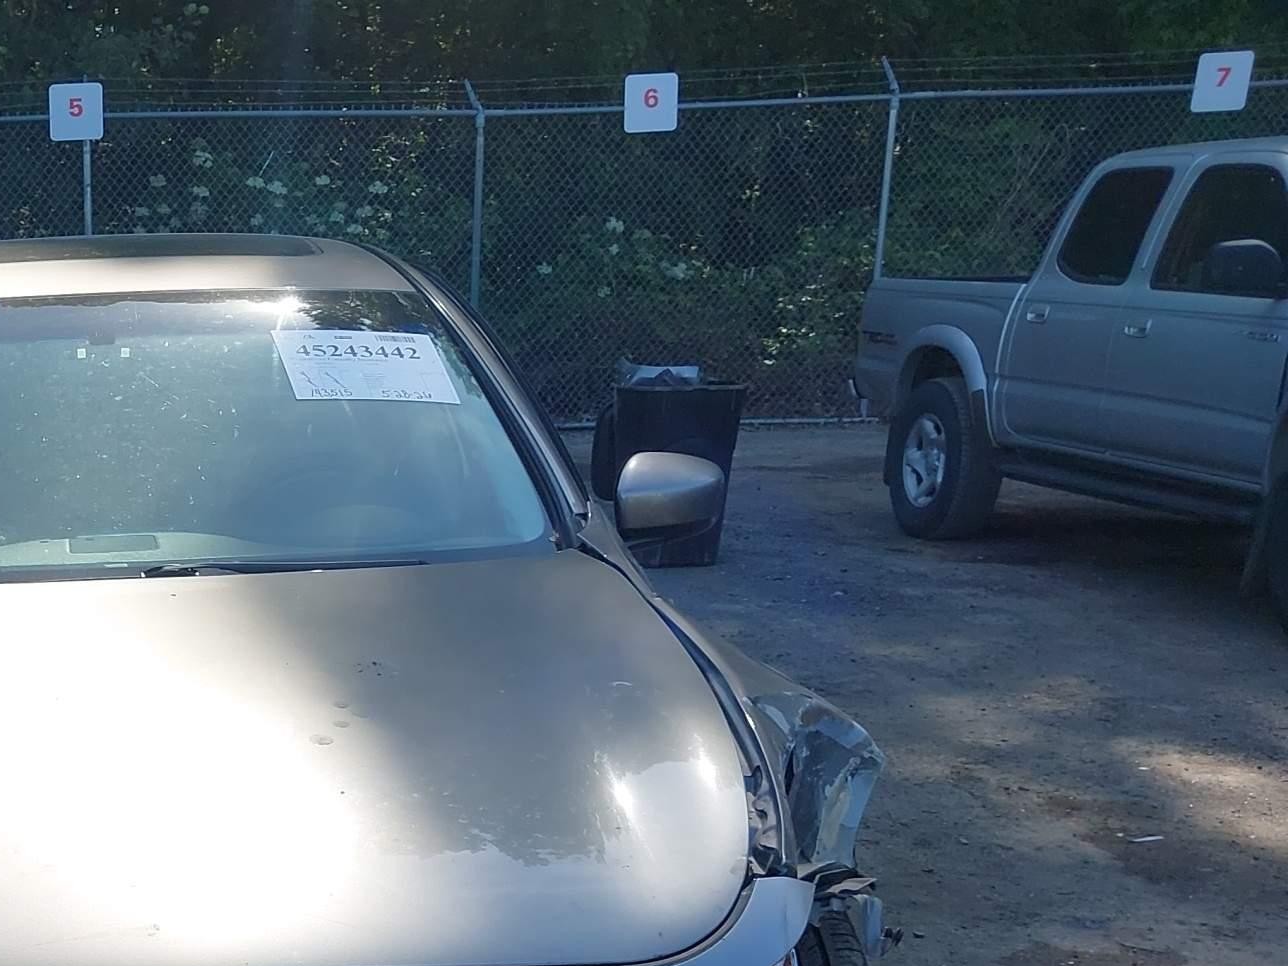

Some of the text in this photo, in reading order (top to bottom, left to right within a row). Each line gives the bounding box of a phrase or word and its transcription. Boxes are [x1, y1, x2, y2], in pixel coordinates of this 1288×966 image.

[1216, 67, 1232, 87] 7
[69, 98, 83, 117] 5
[644, 88, 658, 108] 6
[296, 344, 420, 360] 45243442
